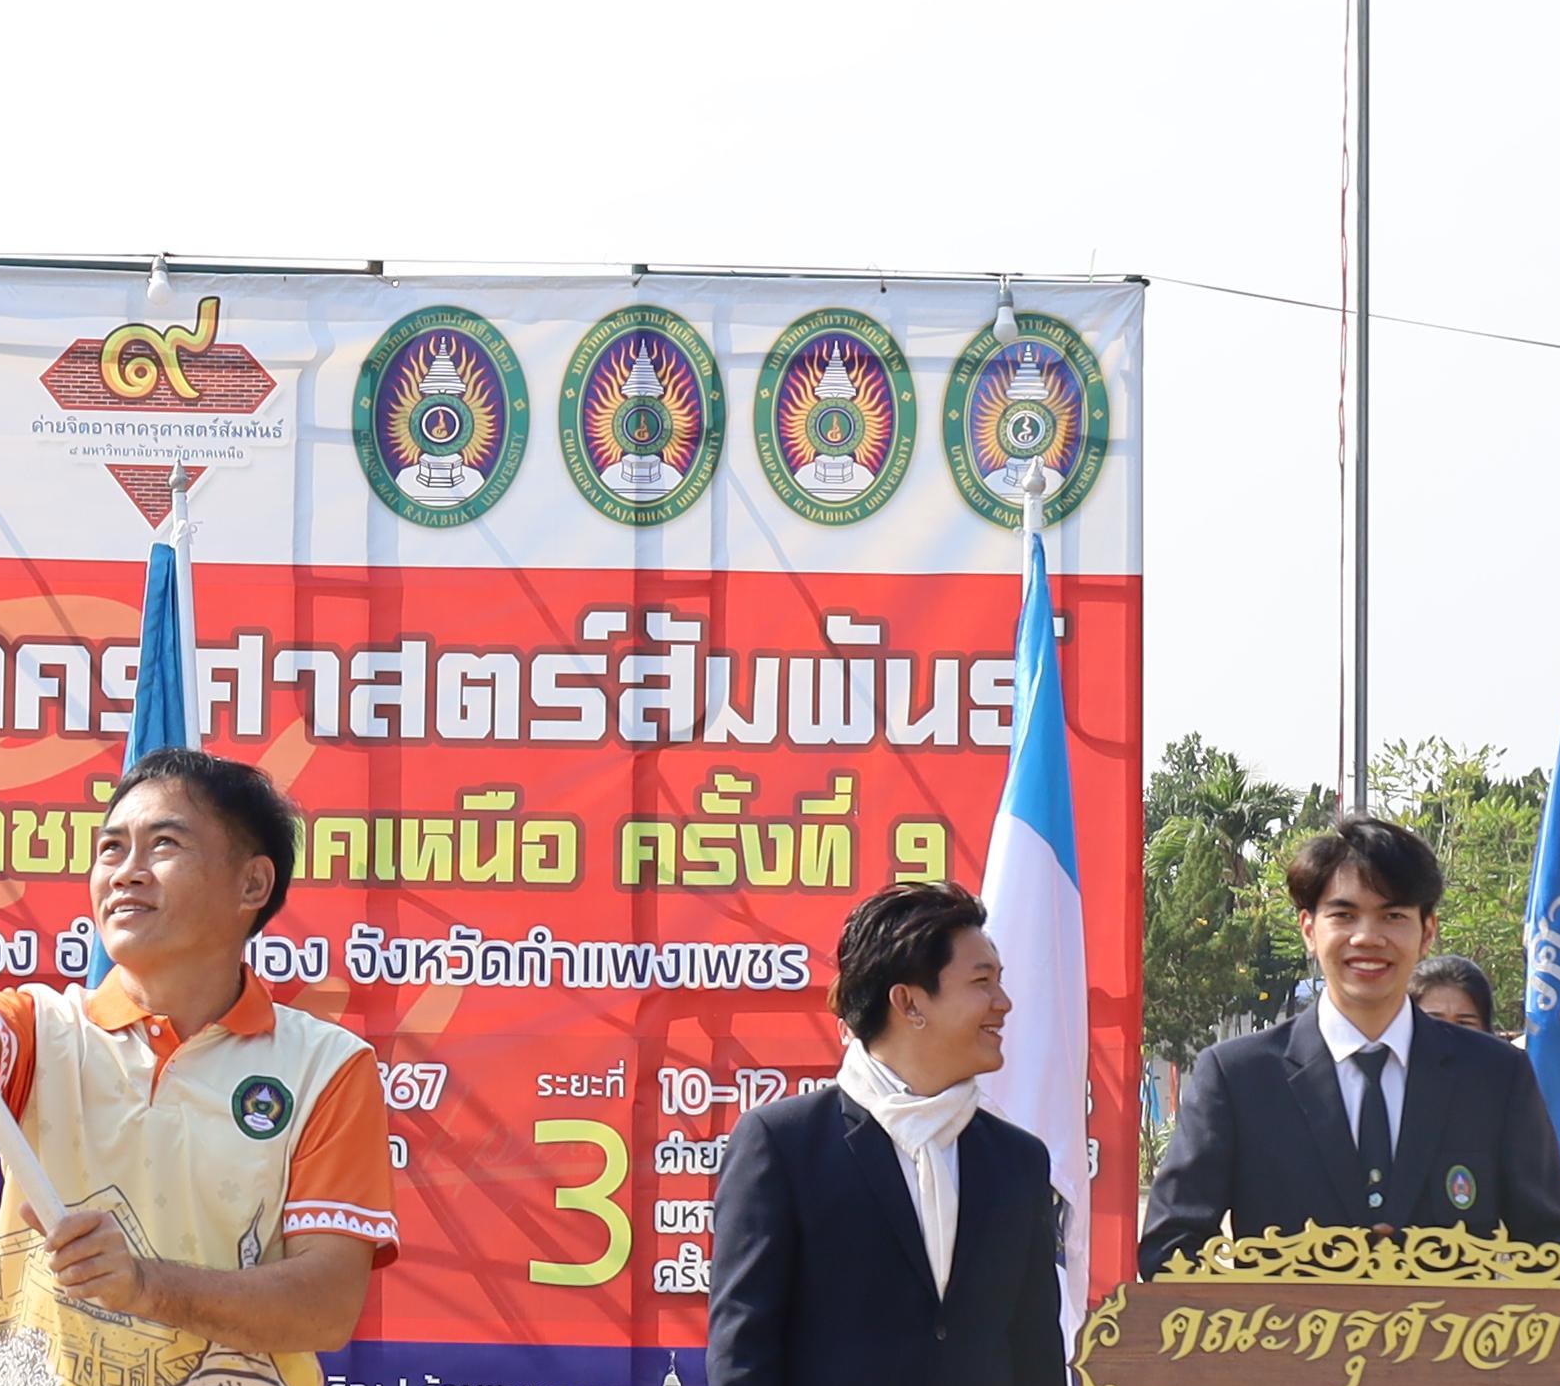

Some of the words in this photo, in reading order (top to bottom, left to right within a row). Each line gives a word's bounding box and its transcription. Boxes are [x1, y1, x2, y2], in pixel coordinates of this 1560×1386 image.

[404, 504, 476, 527] RAJABHAT
[482, 432, 525, 509] UNIVERSITY
[603, 501, 673, 524] RAJABHAT
[676, 429, 721, 508] UNIVERSITY
[758, 433, 792, 500] LAMPANG
[794, 498, 862, 523] RAJABHAT
[864, 435, 911, 510] UNIVERSITY
[951, 444, 992, 512] UTTARADIT
[1056, 444, 1102, 512] UNIVERSITY
[621, 773, 852, 887] ครั้งที่
[895, 822, 947, 883] 9
[348, 926, 808, 988] จังหวัดกำแพงเพชร
[536, 1060, 626, 1098] ระยะที่
[528, 1119, 632, 1287] 3
